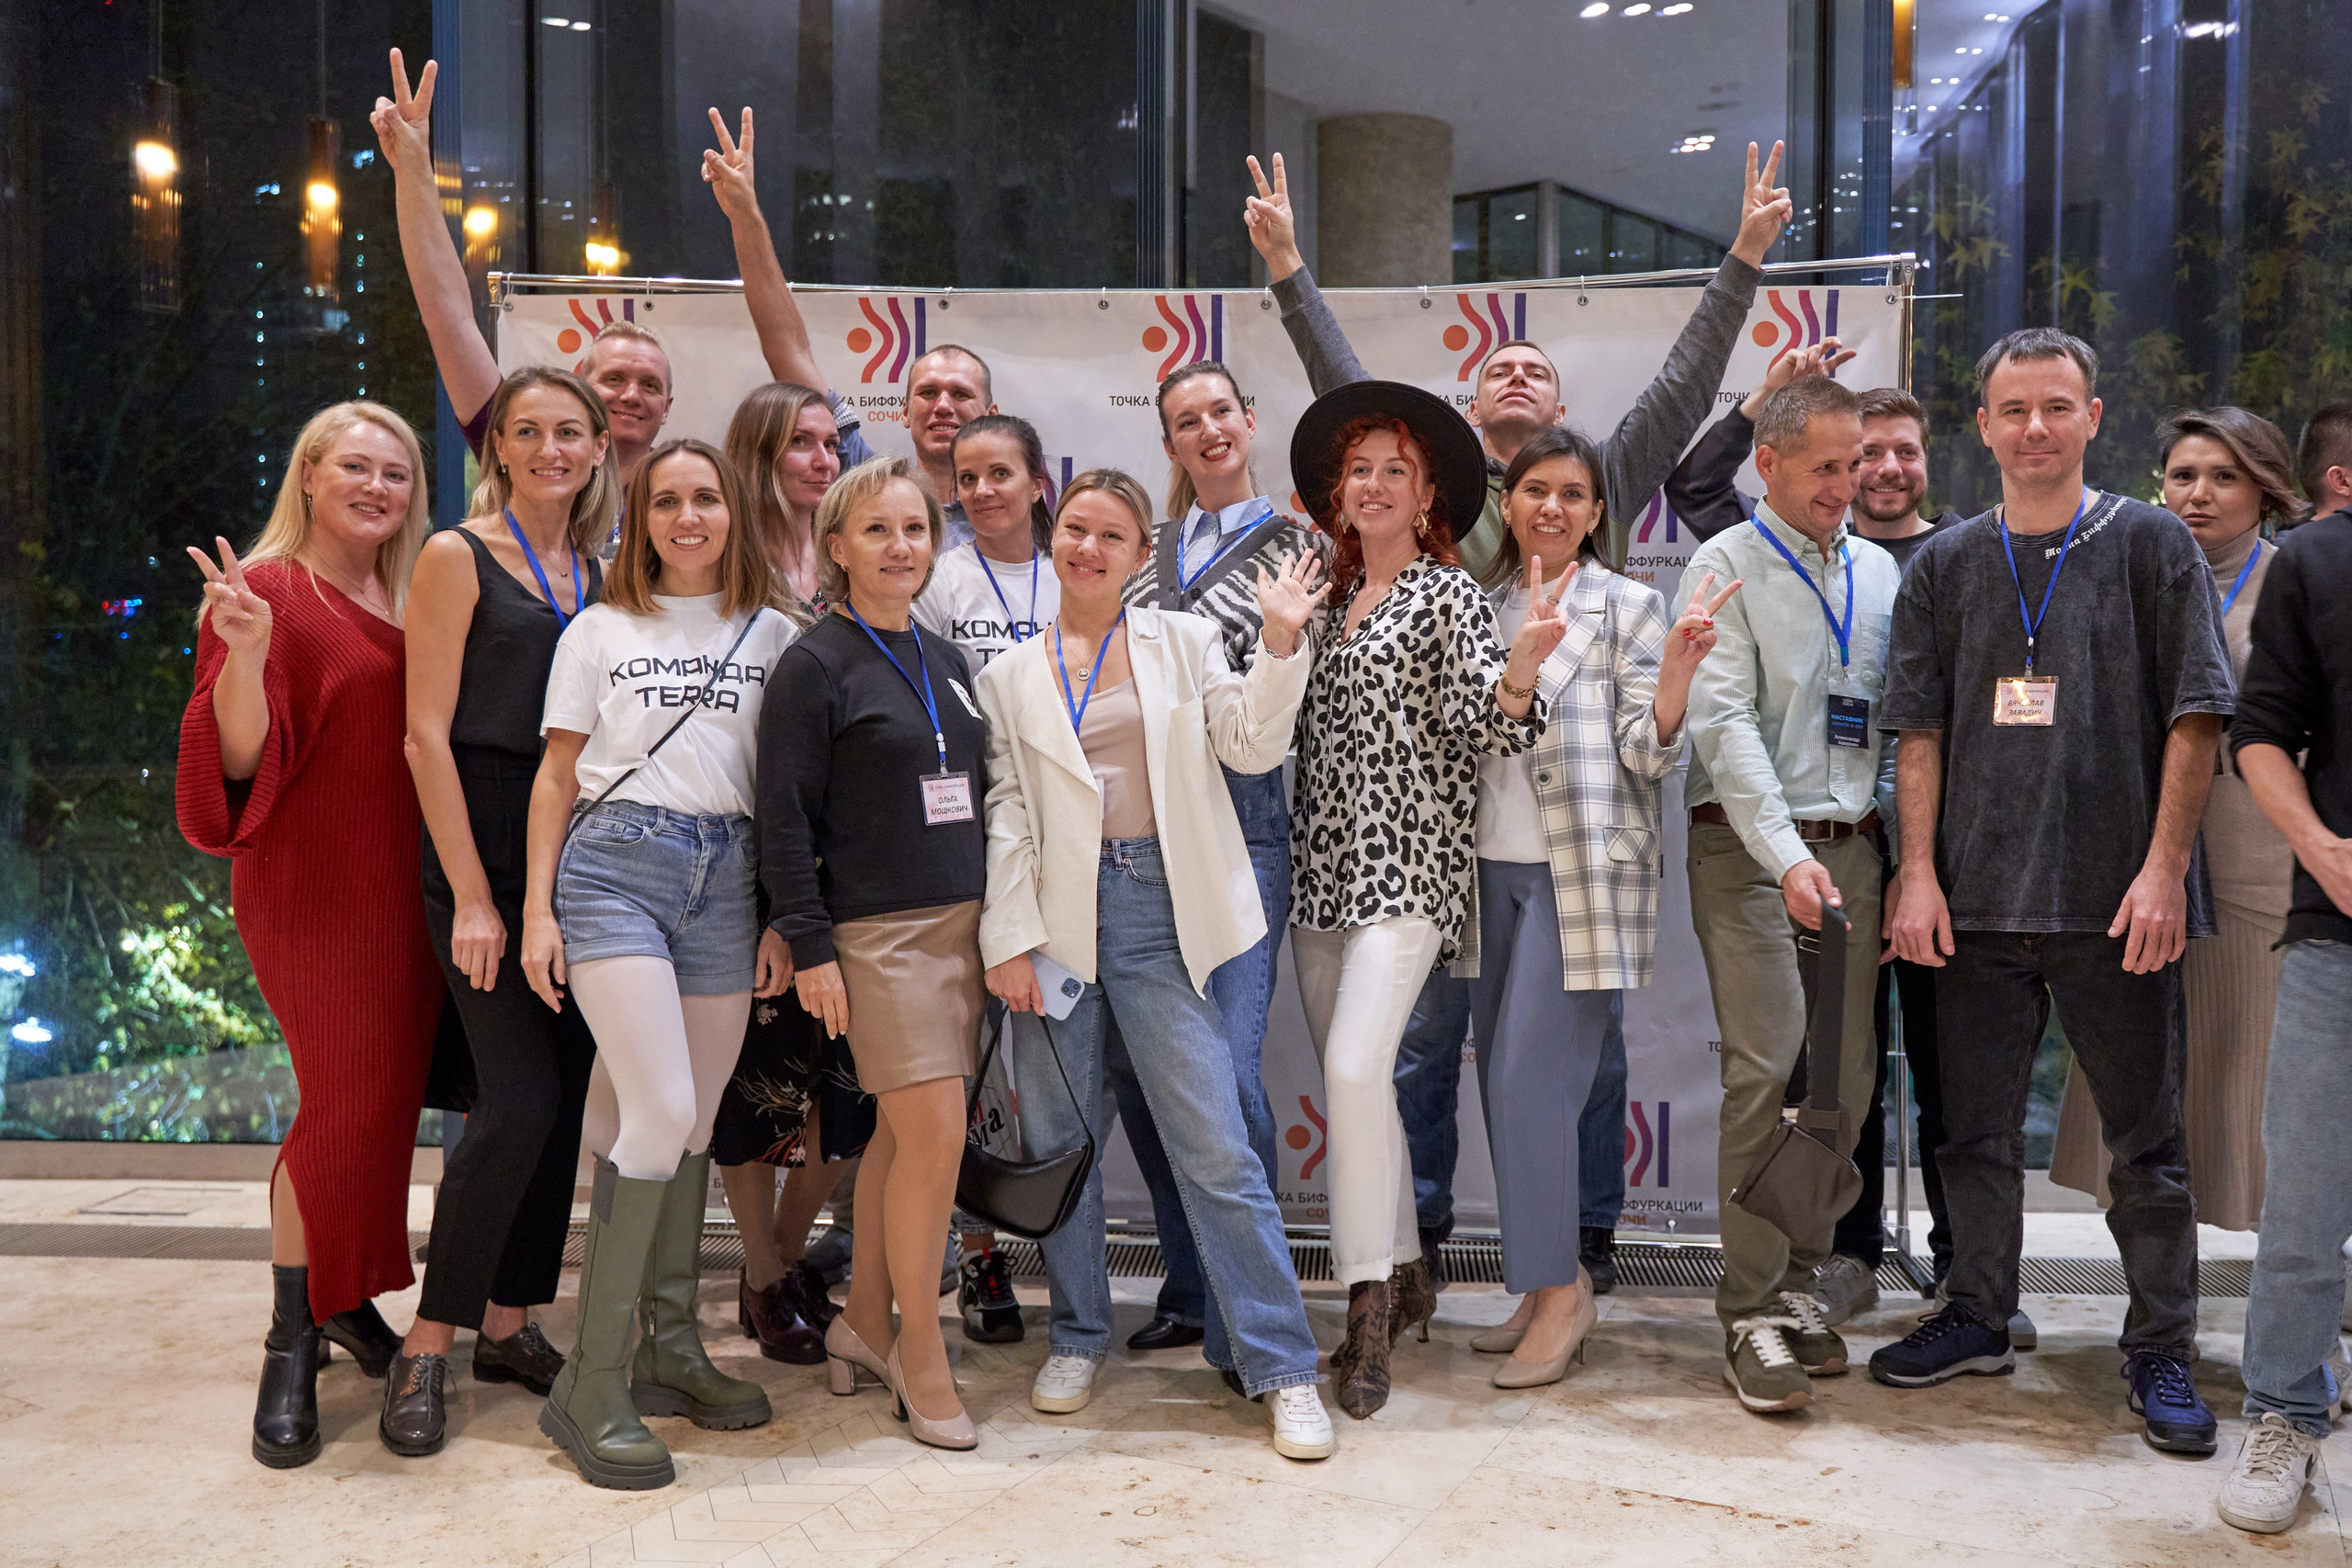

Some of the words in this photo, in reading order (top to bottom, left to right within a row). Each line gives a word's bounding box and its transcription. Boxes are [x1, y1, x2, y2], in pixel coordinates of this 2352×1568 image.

[860, 396, 905, 407] БИФФУ
[1109, 395, 1149, 406] ТОЧКА
[1717, 391, 1750, 403] ТОЧК
[1625, 556, 1691, 567] ФФУРКАЦ
[1623, 570, 1654, 582] ОЧИ
[609, 655, 765, 687] КОМАНДА
[635, 685, 740, 714] TERRA
[938, 795, 958, 804] ОЛЬГА
[931, 806, 968, 815] МОШКОВИЧ
[1276, 1191, 1294, 1202] КА
[1298, 1191, 1329, 1203] БИФ
[1618, 1213, 1646, 1225] ОЧИ
